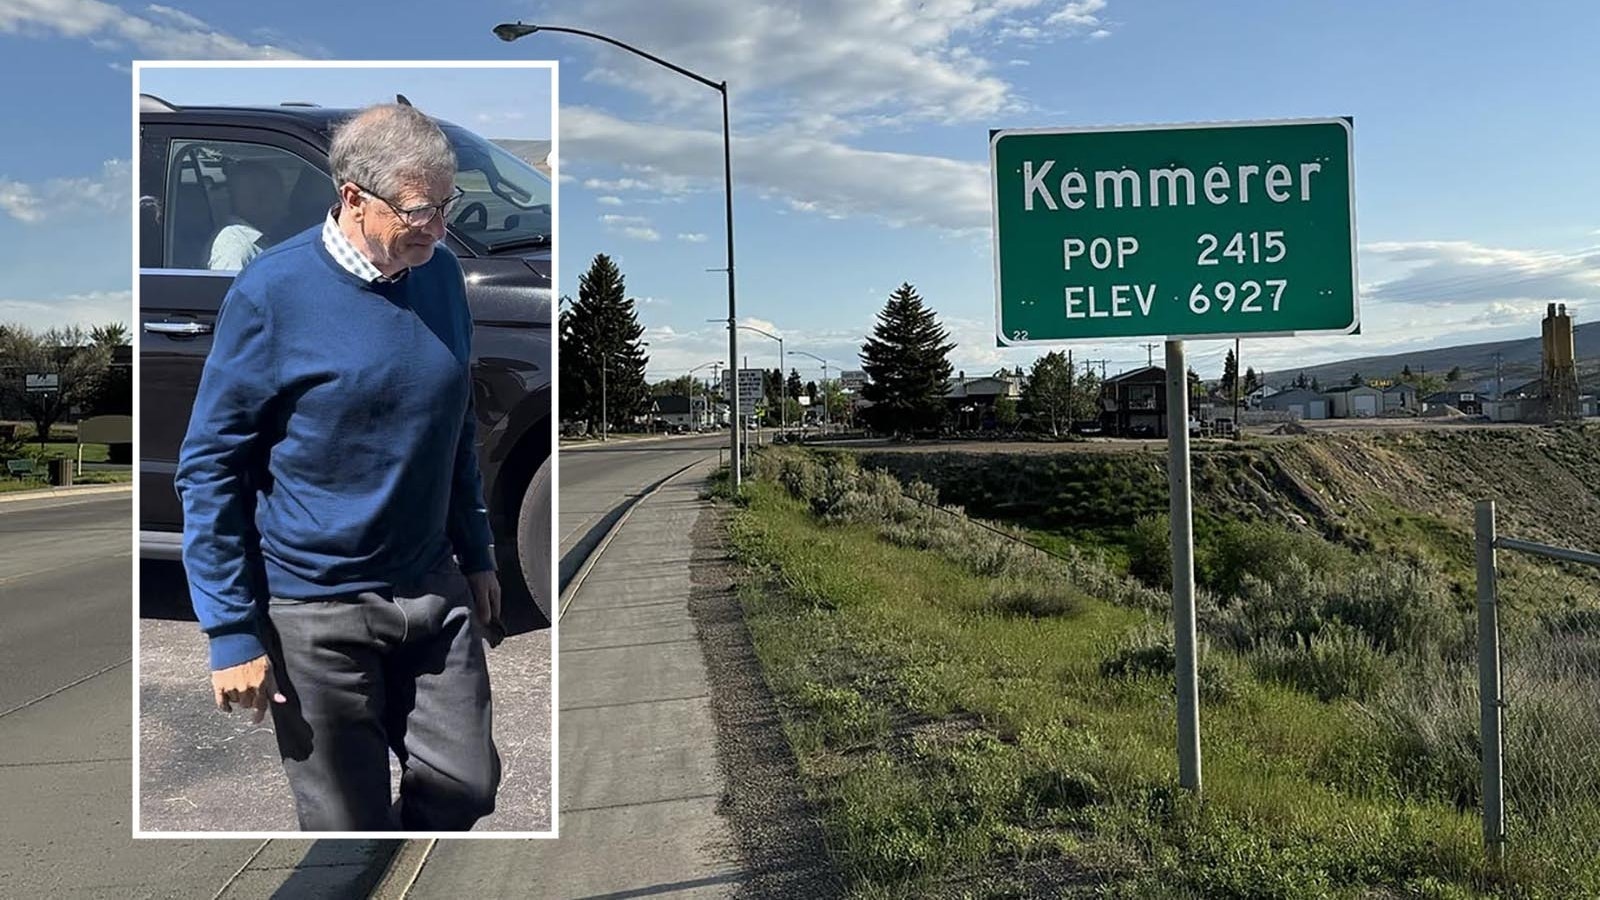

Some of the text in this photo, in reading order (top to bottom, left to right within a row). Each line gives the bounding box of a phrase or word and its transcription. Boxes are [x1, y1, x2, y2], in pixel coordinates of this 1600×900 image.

[1023, 160, 1321, 211] Kemmerer
[1063, 231, 1287, 270] POP 2415
[1065, 280, 1287, 319] ELEV 6927
[1013, 330, 1029, 341] 22
